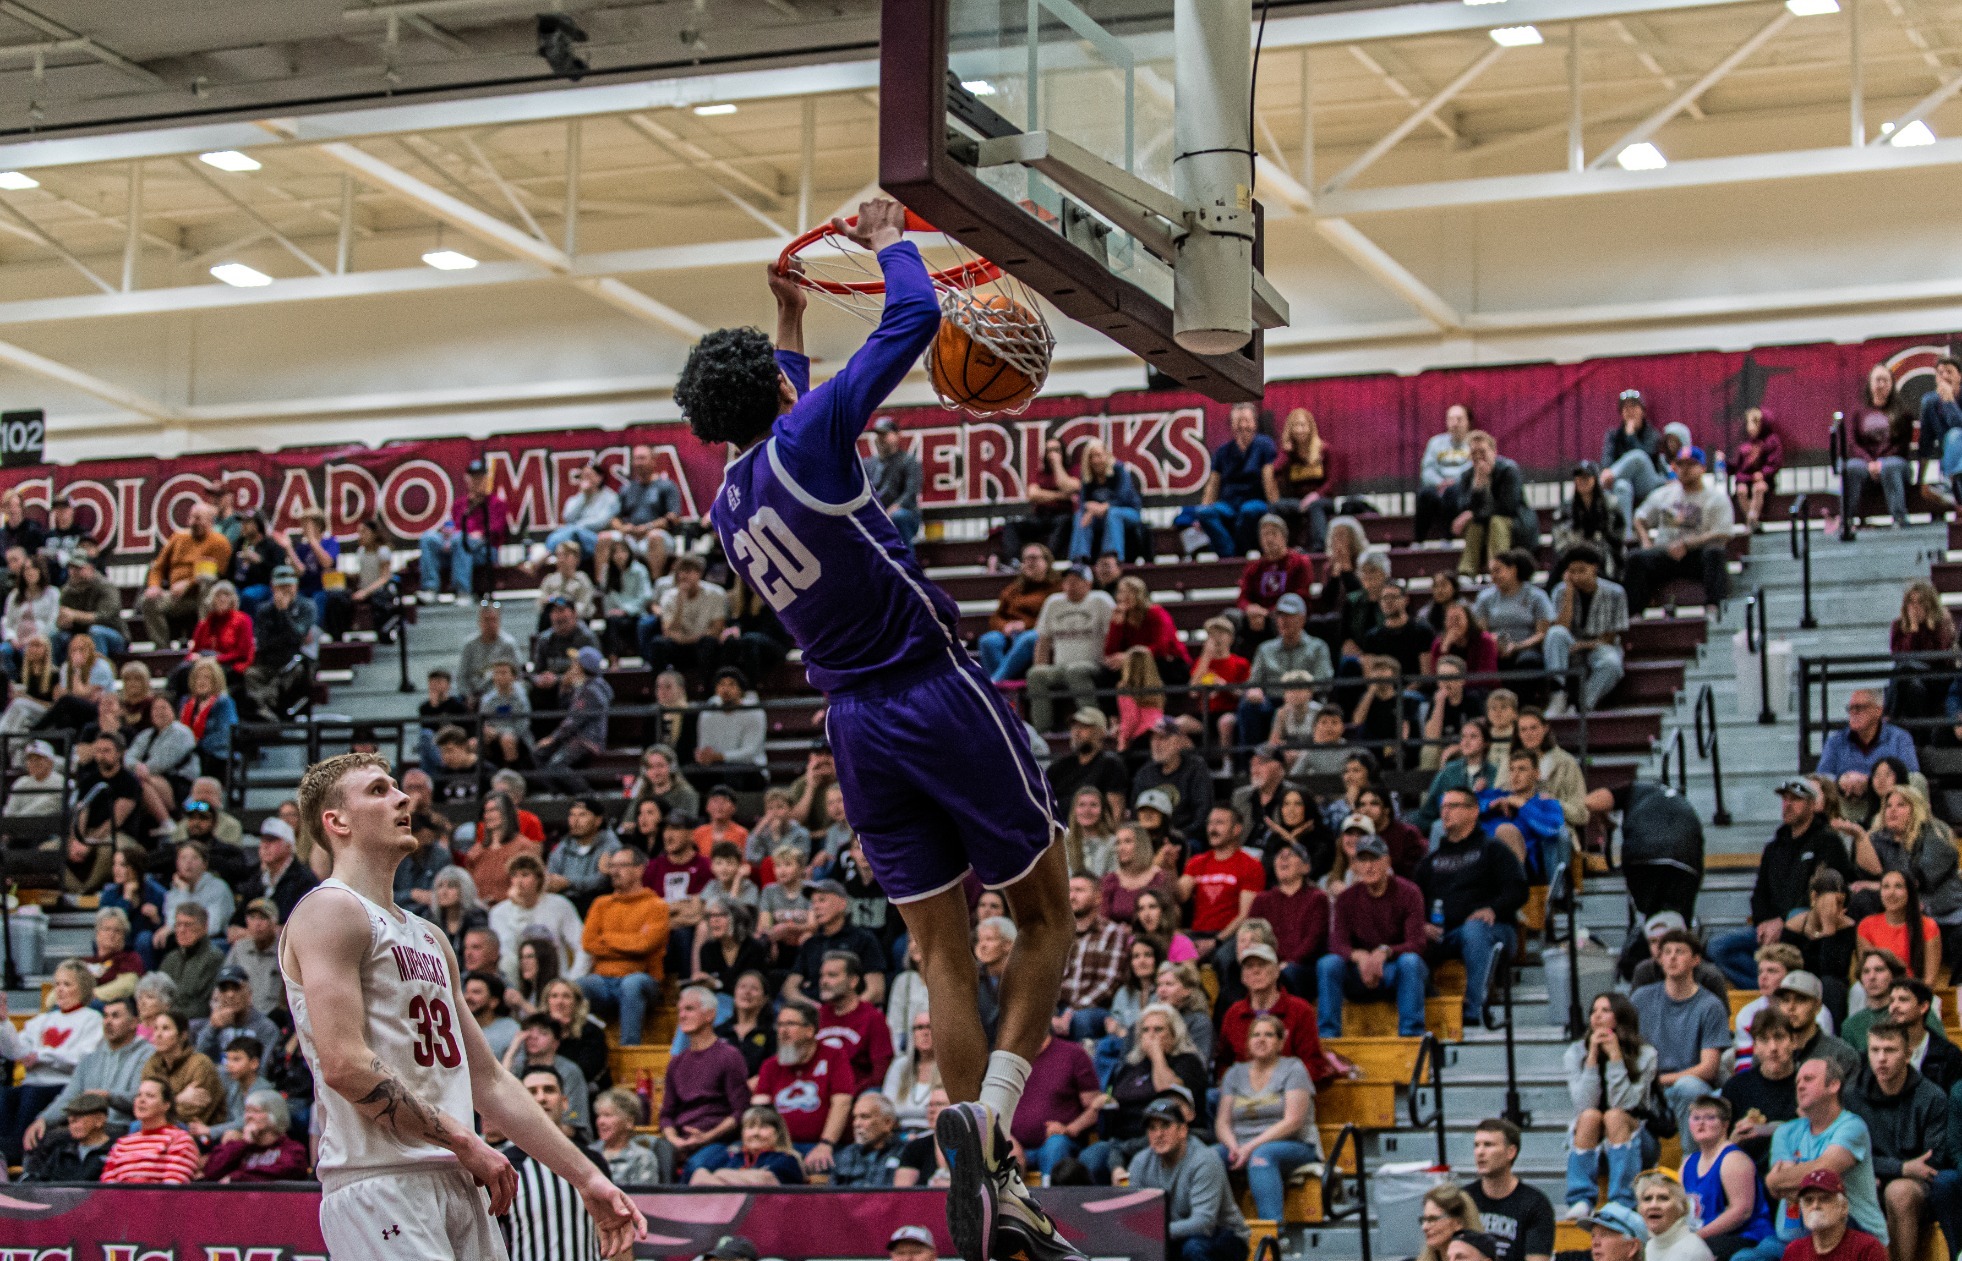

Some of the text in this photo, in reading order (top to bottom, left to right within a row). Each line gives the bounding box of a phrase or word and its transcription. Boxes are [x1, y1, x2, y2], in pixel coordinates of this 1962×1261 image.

[0, 421, 44, 453] 102
[733, 506, 822, 612] 20
[391, 945, 447, 988] MAVERICKS
[409, 994, 462, 1068] 33
